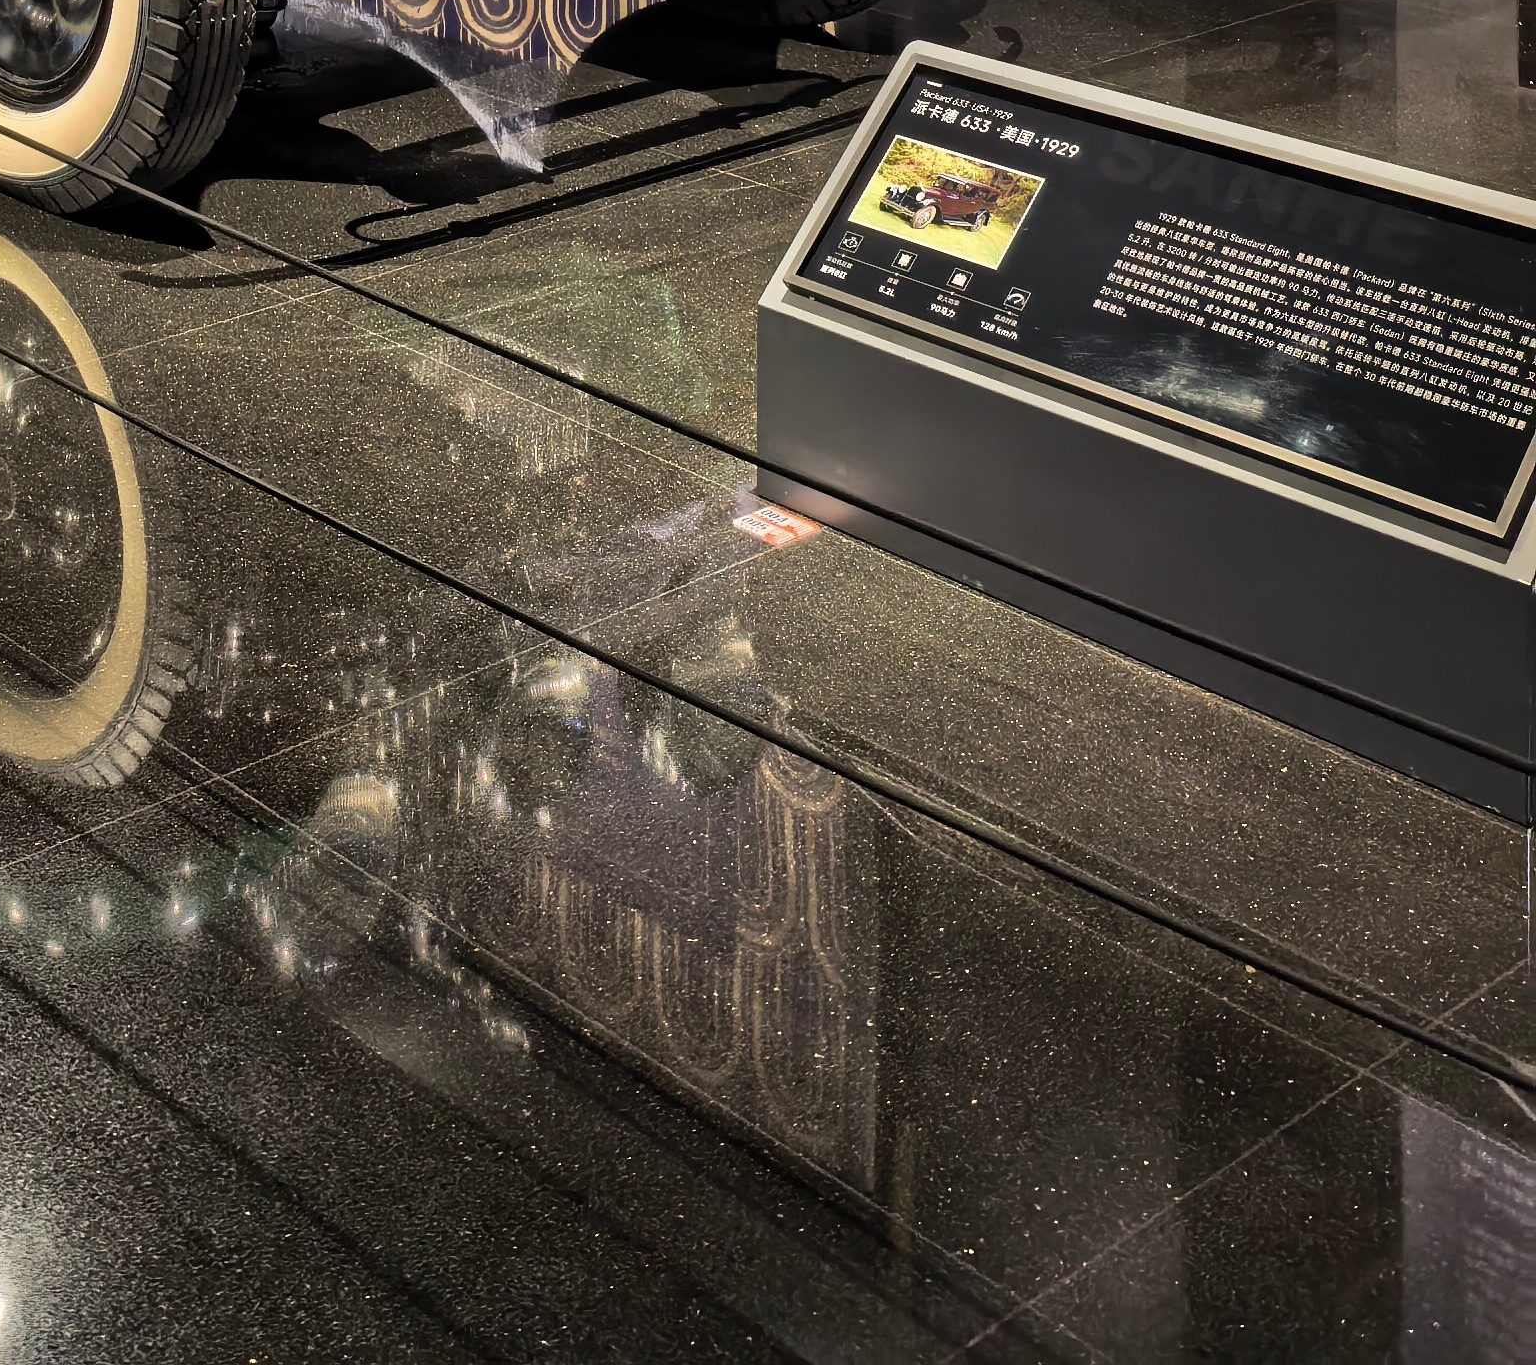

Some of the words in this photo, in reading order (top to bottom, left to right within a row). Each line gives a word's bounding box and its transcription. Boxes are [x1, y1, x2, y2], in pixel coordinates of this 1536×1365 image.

[919, 88, 953, 103] Packard
[910, 97, 959, 124] 派卡德
[959, 112, 992, 133] 633
[1165, 243, 1188, 258] 3200
[1157, 211, 1178, 224] 1929
[1211, 227, 1229, 239] 633
[1228, 232, 1267, 250] Standard
[1505, 314, 1536, 332] Series
[1098, 285, 1125, 300] 20-30
[1252, 334, 1275, 349] 1929
[1401, 349, 1421, 363] 633
[1420, 355, 1464, 376] Standard
[1463, 368, 1491, 386] Eight
